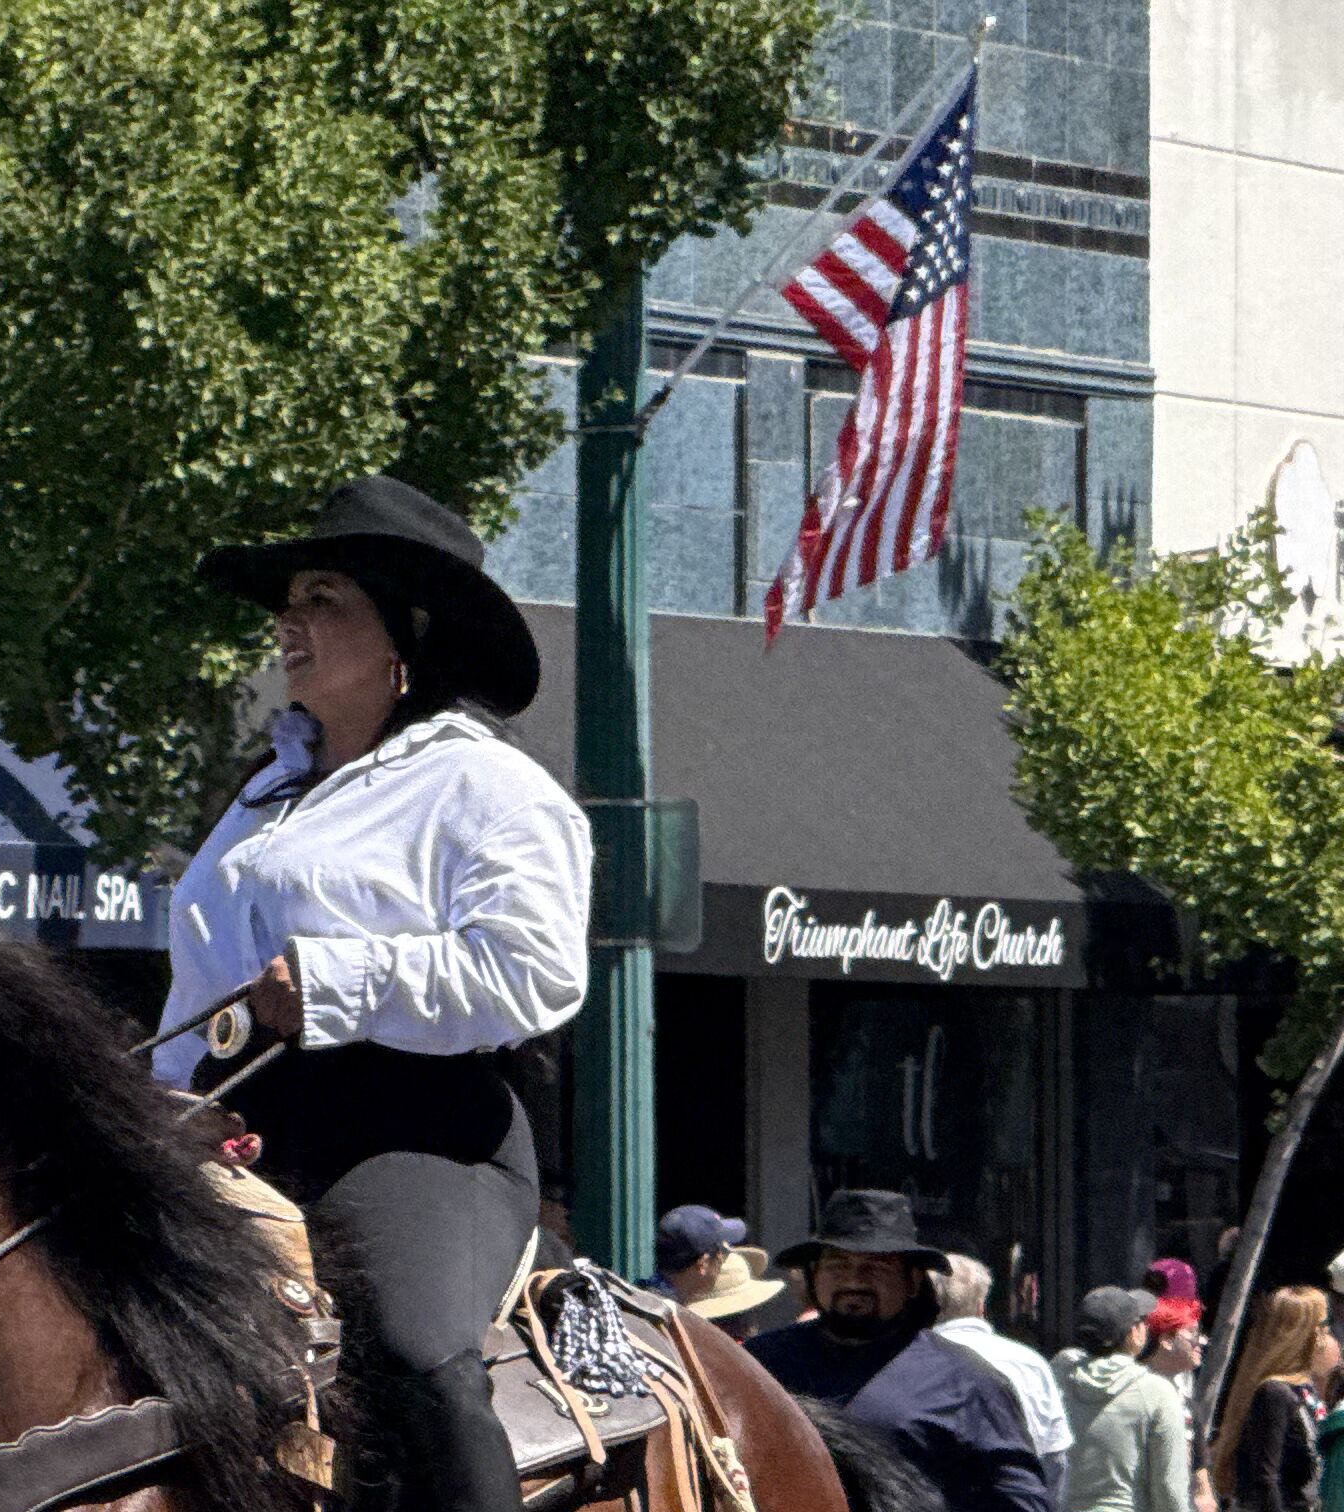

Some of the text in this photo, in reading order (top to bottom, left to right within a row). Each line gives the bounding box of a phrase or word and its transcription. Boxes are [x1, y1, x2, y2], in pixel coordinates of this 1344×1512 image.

[25, 872, 86, 920] NAIL
[94, 873, 144, 921] SPA
[764, 885, 1064, 981] Triumphant Life Church
